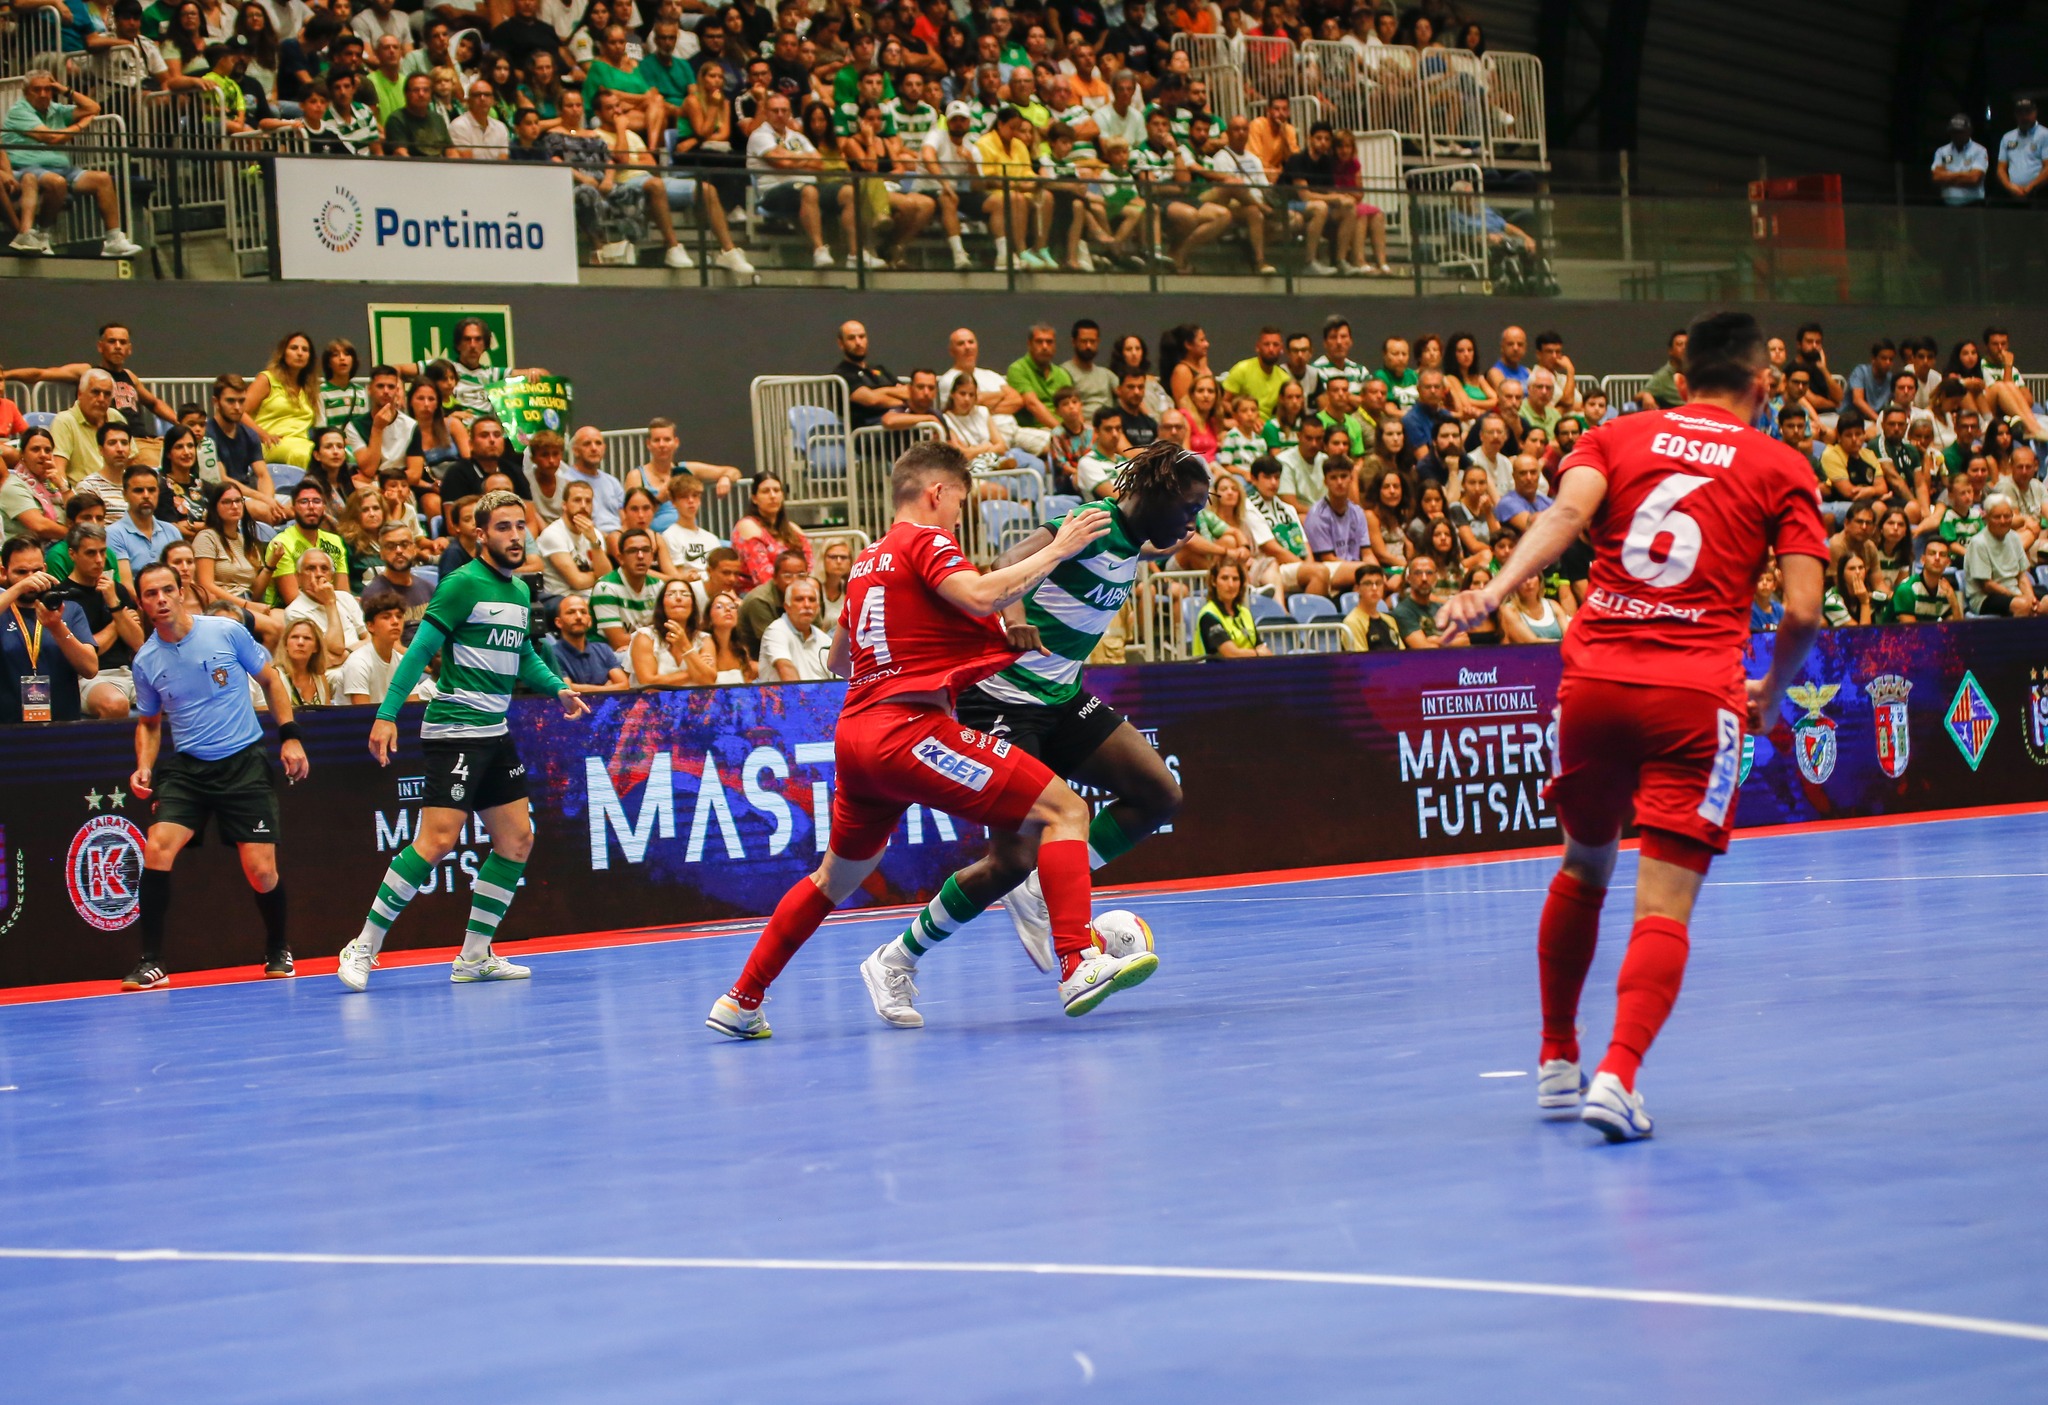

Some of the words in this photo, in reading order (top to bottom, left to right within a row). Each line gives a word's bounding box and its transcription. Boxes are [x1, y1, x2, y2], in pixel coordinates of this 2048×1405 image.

[374, 207, 544, 250] Portimão
[118, 260, 132, 279] B
[504, 398, 524, 409] DO
[529, 396, 567, 411] MELHOR
[523, 410, 541, 421] DO
[1651, 433, 1736, 468] EDSON
[1621, 473, 1715, 588] 6
[875, 553, 896, 572] JR.
[1458, 666, 1498, 686] Record
[1421, 691, 1538, 715] INTERNATIONAL
[450, 752, 469, 782] 4
[918, 743, 987, 783] 1XBET
[1416, 778, 1558, 840] FUTSAL
[87, 815, 130, 833] KAIRAT
